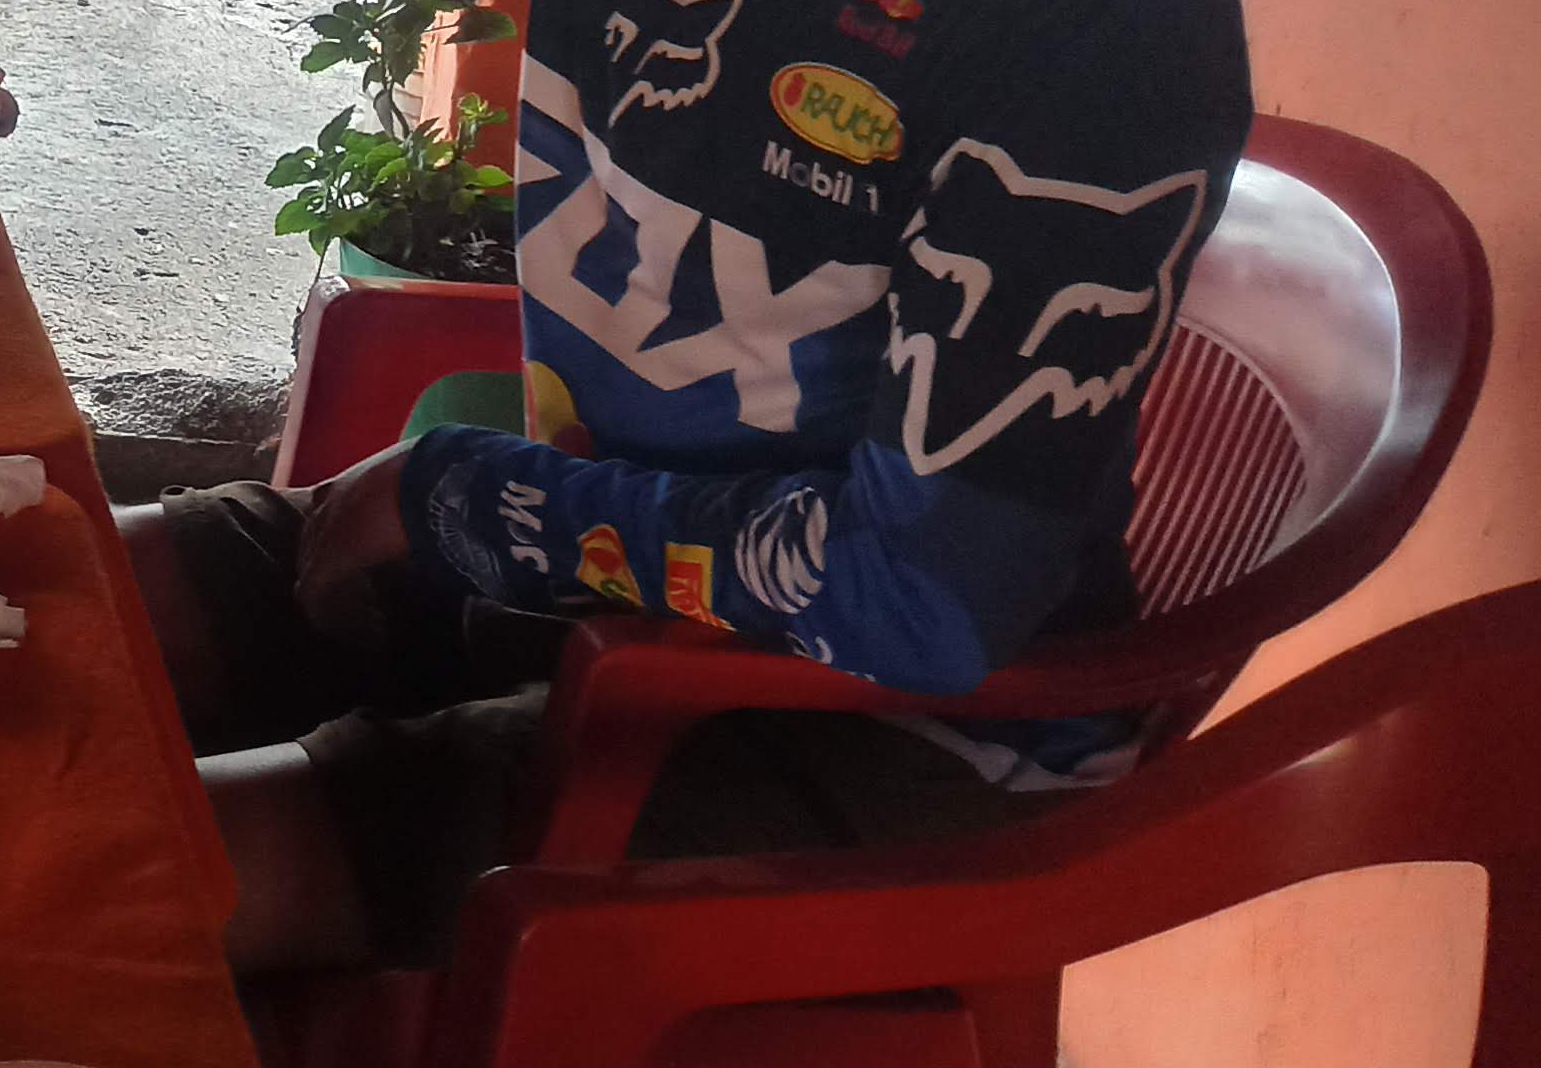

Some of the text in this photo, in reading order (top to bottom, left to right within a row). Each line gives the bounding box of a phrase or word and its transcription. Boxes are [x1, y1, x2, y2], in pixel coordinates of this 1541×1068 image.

[800, 82, 894, 147] RAUCH
[762, 140, 879, 213] Mobil 1
